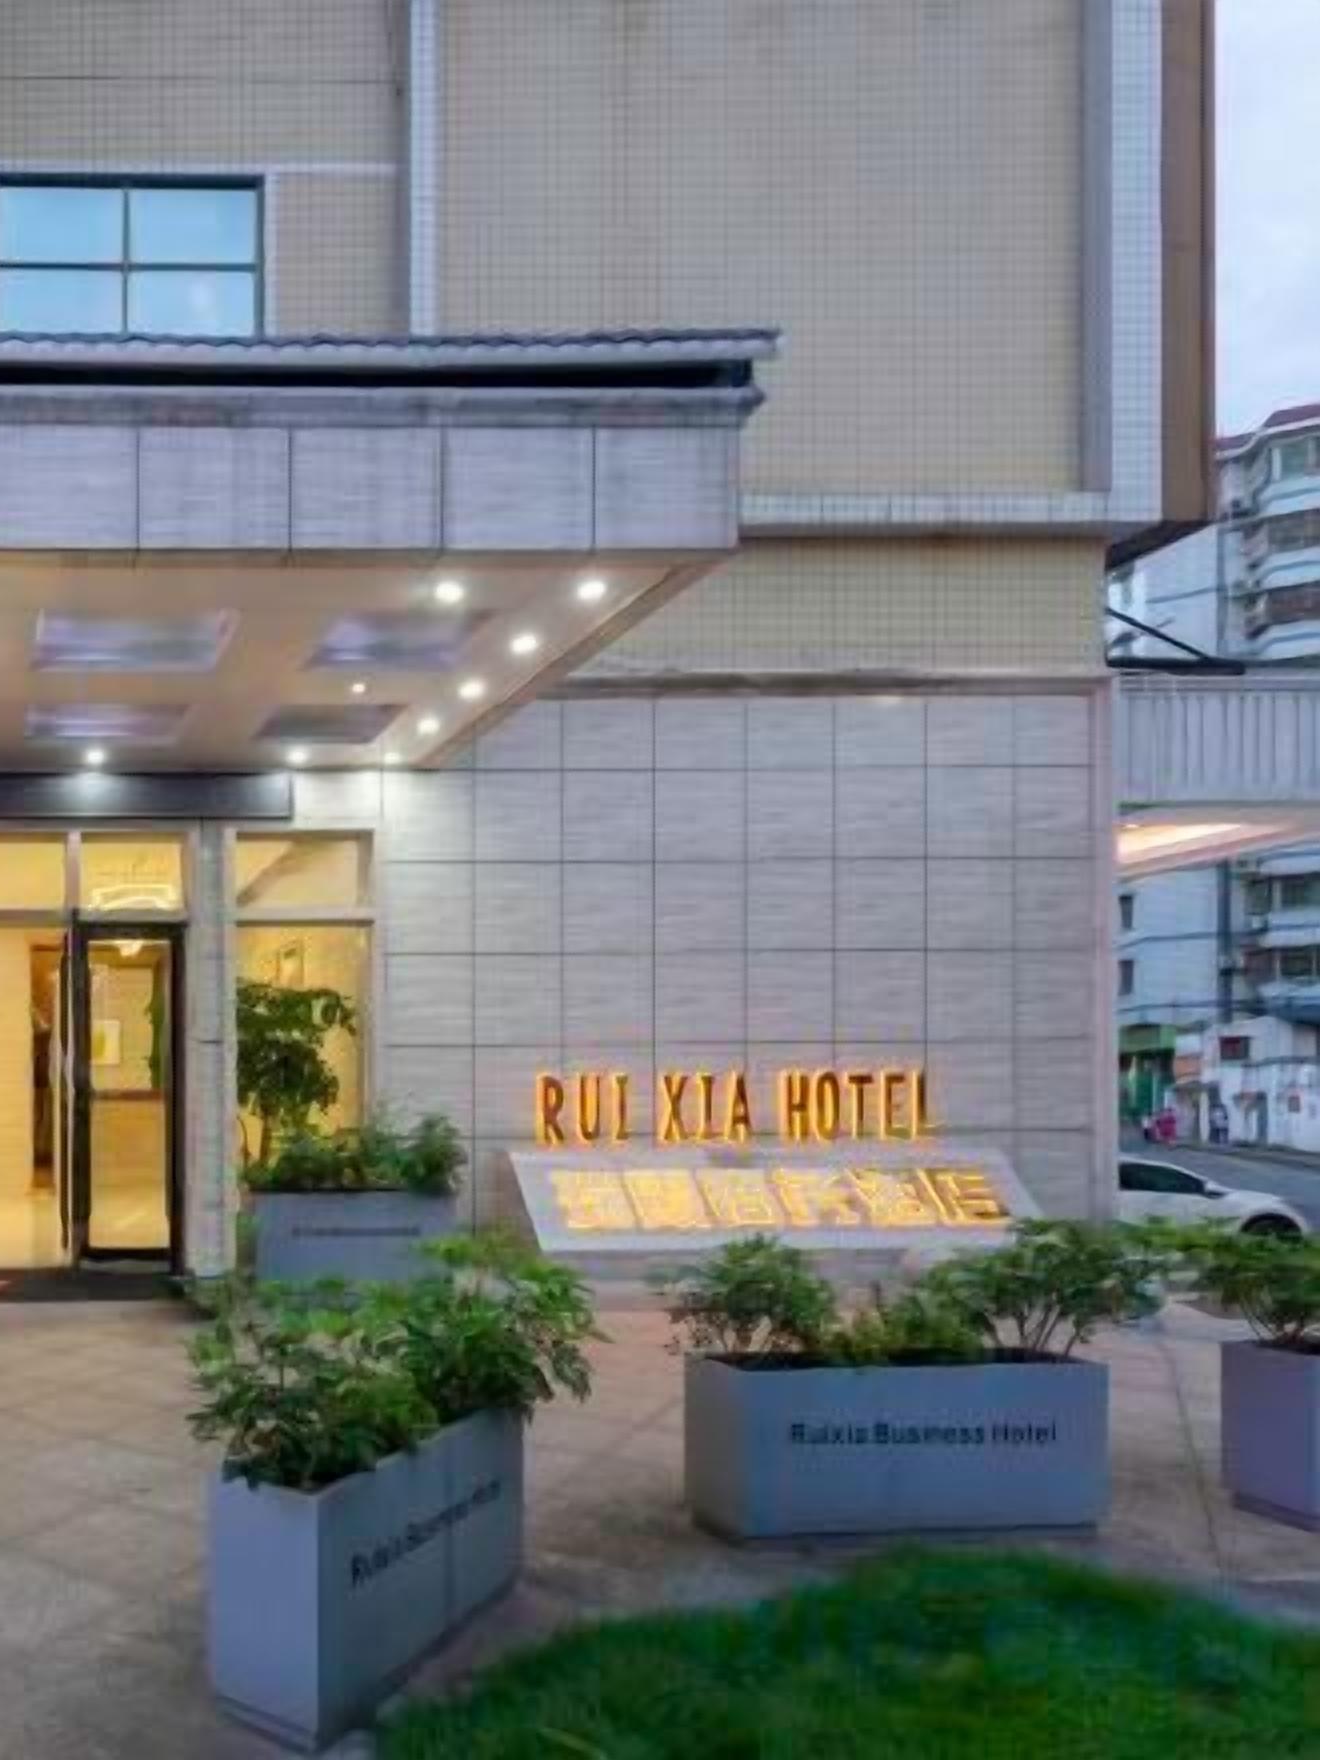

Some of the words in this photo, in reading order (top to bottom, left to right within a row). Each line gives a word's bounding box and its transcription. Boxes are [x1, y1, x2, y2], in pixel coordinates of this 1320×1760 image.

[536, 1073, 629, 1144] RUI
[659, 1072, 754, 1144] XIA
[780, 1070, 938, 1143] HOTEL
[875, 1422, 984, 1444] Business
[990, 1420, 1057, 1442] Hotel
